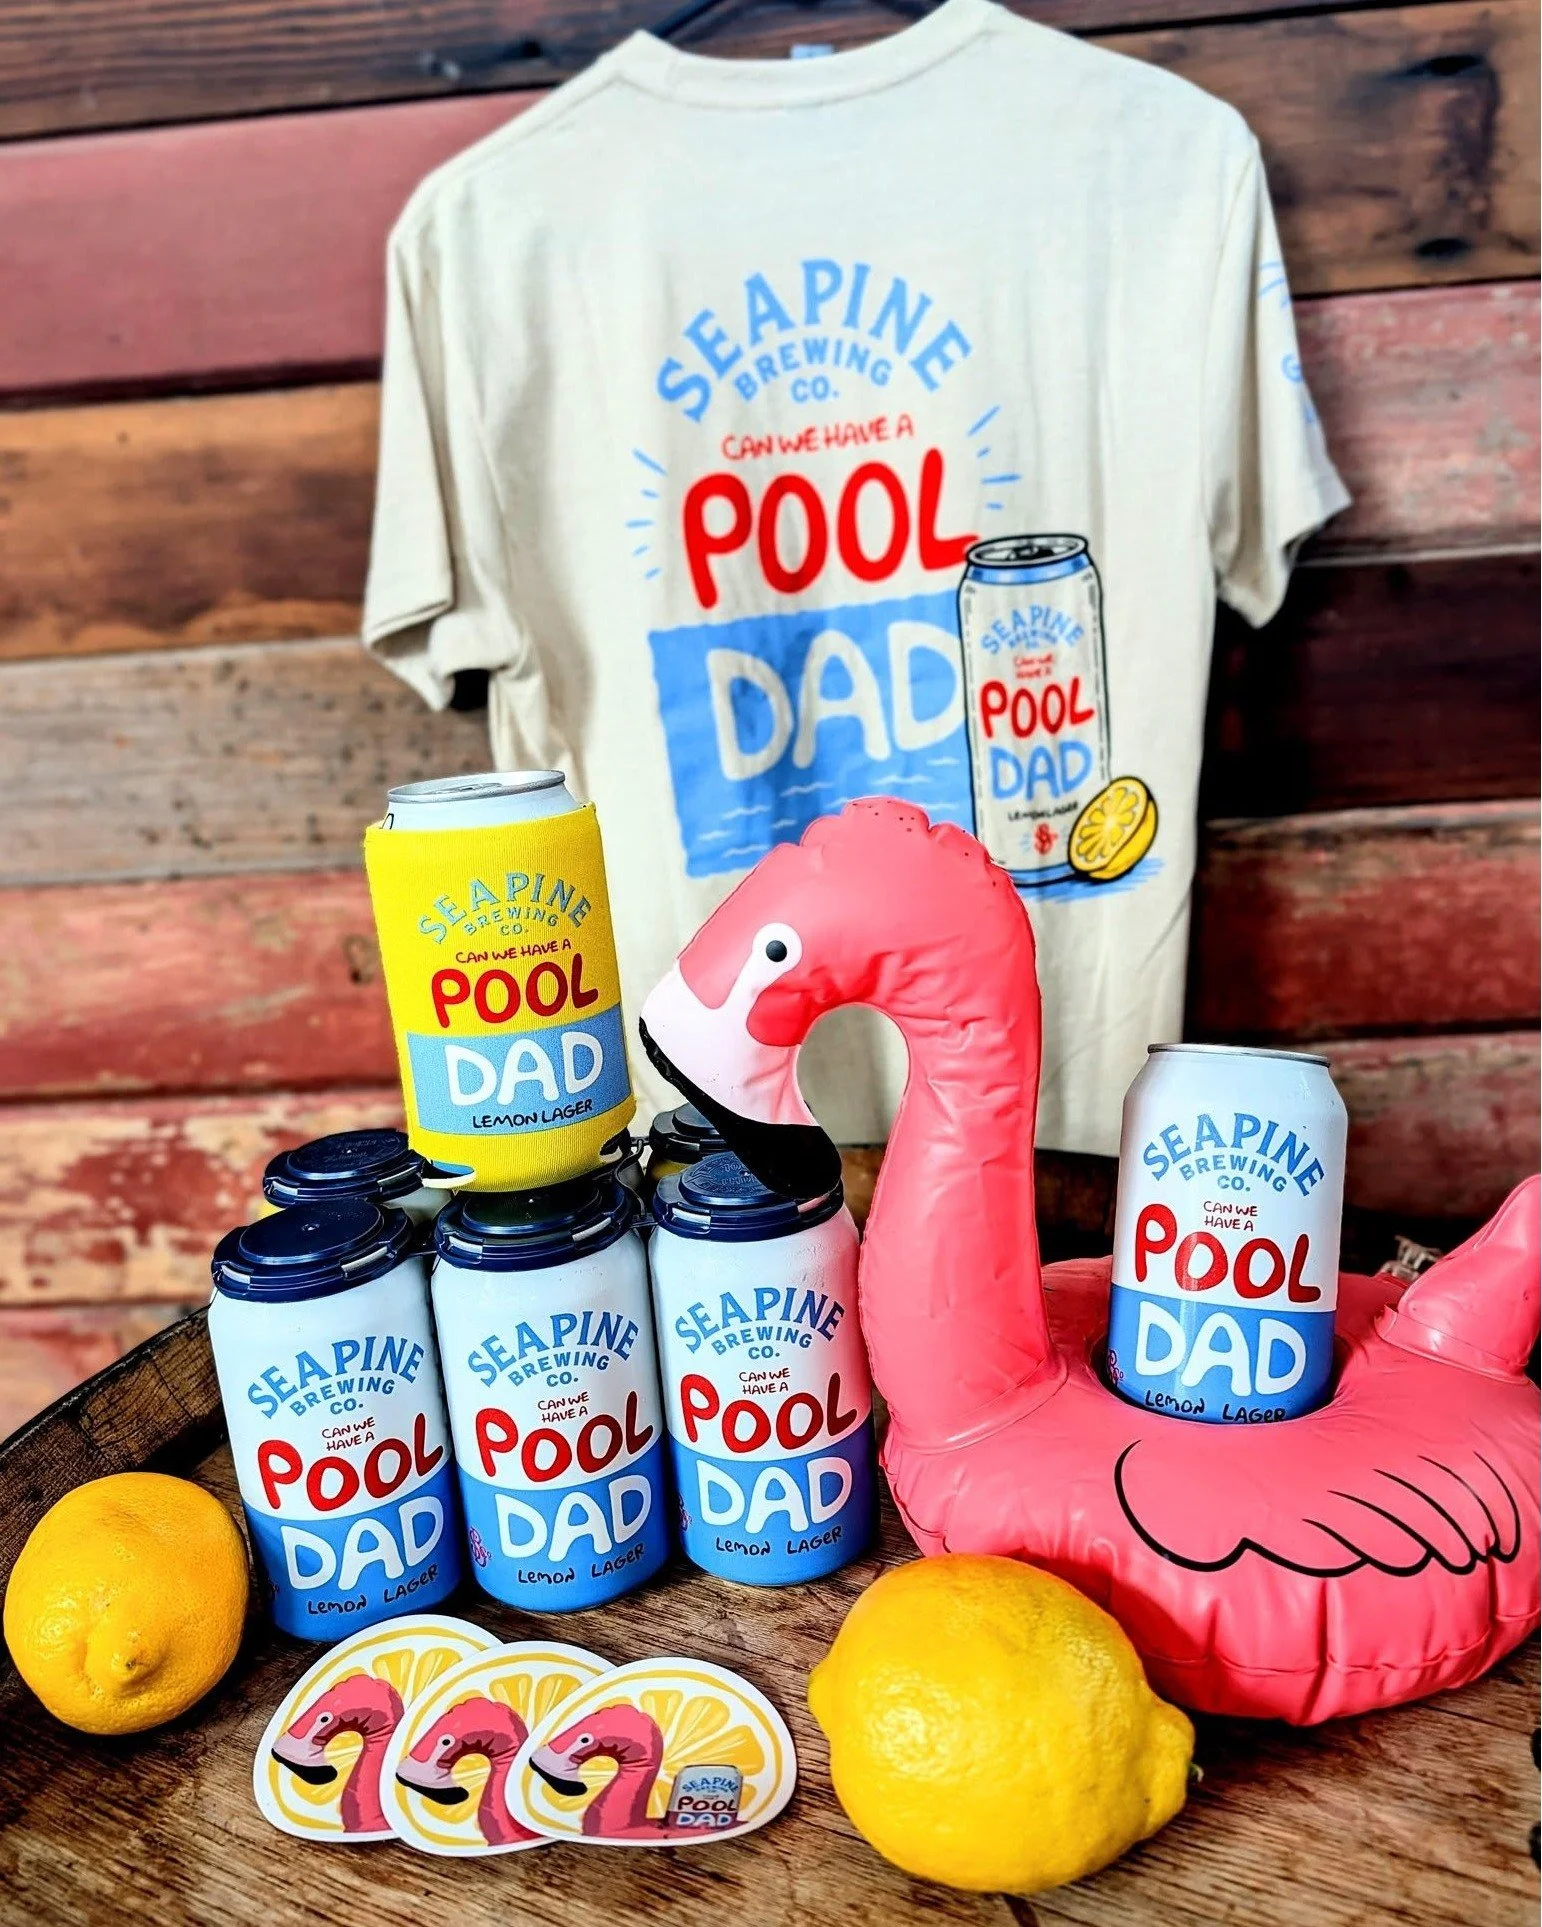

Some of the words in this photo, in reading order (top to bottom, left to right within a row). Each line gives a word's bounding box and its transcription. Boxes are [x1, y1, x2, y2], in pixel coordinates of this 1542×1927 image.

[657, 258, 973, 423] SEAPINE
[733, 336, 893, 402] BREWING
[790, 375, 840, 403] CO.
[721, 433, 774, 461] CAN
[778, 426, 821, 453] WE
[824, 415, 889, 449] HAVE
[896, 413, 914, 439] A
[683, 447, 979, 609] POOL
[981, 604, 1084, 655] SEAPINE
[706, 620, 965, 781] DAD
[979, 676, 1094, 738] POOL
[989, 740, 1093, 801] DAD
[418, 872, 594, 943] SEAPINE
[463, 906, 559, 936] BREWING
[500, 921, 529, 935] CO.
[455, 950, 489, 964] CAN
[492, 948, 519, 960] WE
[521, 939, 558, 957] HAVE
[560, 938, 572, 950] A
[431, 953, 599, 1028] POOL
[443, 1031, 603, 1107] DAD
[473, 1112, 537, 1129] LEMON
[541, 1099, 593, 1124] LAGER
[1142, 1112, 1327, 1197] SEAPINE
[1179, 1154, 1288, 1193] BREWING
[1216, 1175, 1251, 1192] CO.
[1203, 1200, 1234, 1214] CAN
[1235, 1204, 1258, 1217] WE
[1204, 1216, 1241, 1230] HAVE
[1243, 1221, 1254, 1232] A
[1134, 1203, 1322, 1303] POOL
[674, 1287, 845, 1354] SEAPINE
[711, 1326, 812, 1356] BREWING
[467, 1310, 639, 1388] SEAPINE
[508, 1351, 610, 1387] BREWING
[748, 1345, 780, 1360] CO.
[1135, 1300, 1307, 1397] DAD
[247, 1335, 424, 1420] SEAPINE
[290, 1376, 395, 1417] BREWING
[546, 1372, 579, 1387] CO.
[739, 1371, 767, 1383] CAN
[768, 1368, 791, 1380] WE
[742, 1383, 778, 1395] HAVE
[779, 1382, 789, 1392] A
[330, 1398, 364, 1415] CO.
[537, 1398, 566, 1411] CAN
[568, 1391, 589, 1404] WE
[541, 1409, 577, 1423] HAVE
[578, 1406, 588, 1417] A
[679, 1372, 857, 1454] POOL
[322, 1424, 351, 1440] CAN
[354, 1417, 376, 1431] WE
[326, 1436, 362, 1452] HAVE
[364, 1431, 375, 1443] A
[475, 1390, 654, 1483] POOL
[258, 1413, 444, 1511] POOL
[696, 1456, 853, 1535] DAD
[494, 1474, 651, 1562] DAD
[281, 1496, 444, 1590] DAD
[676, 1813, 732, 1826] DAD
[678, 1795, 737, 1812] POOL
